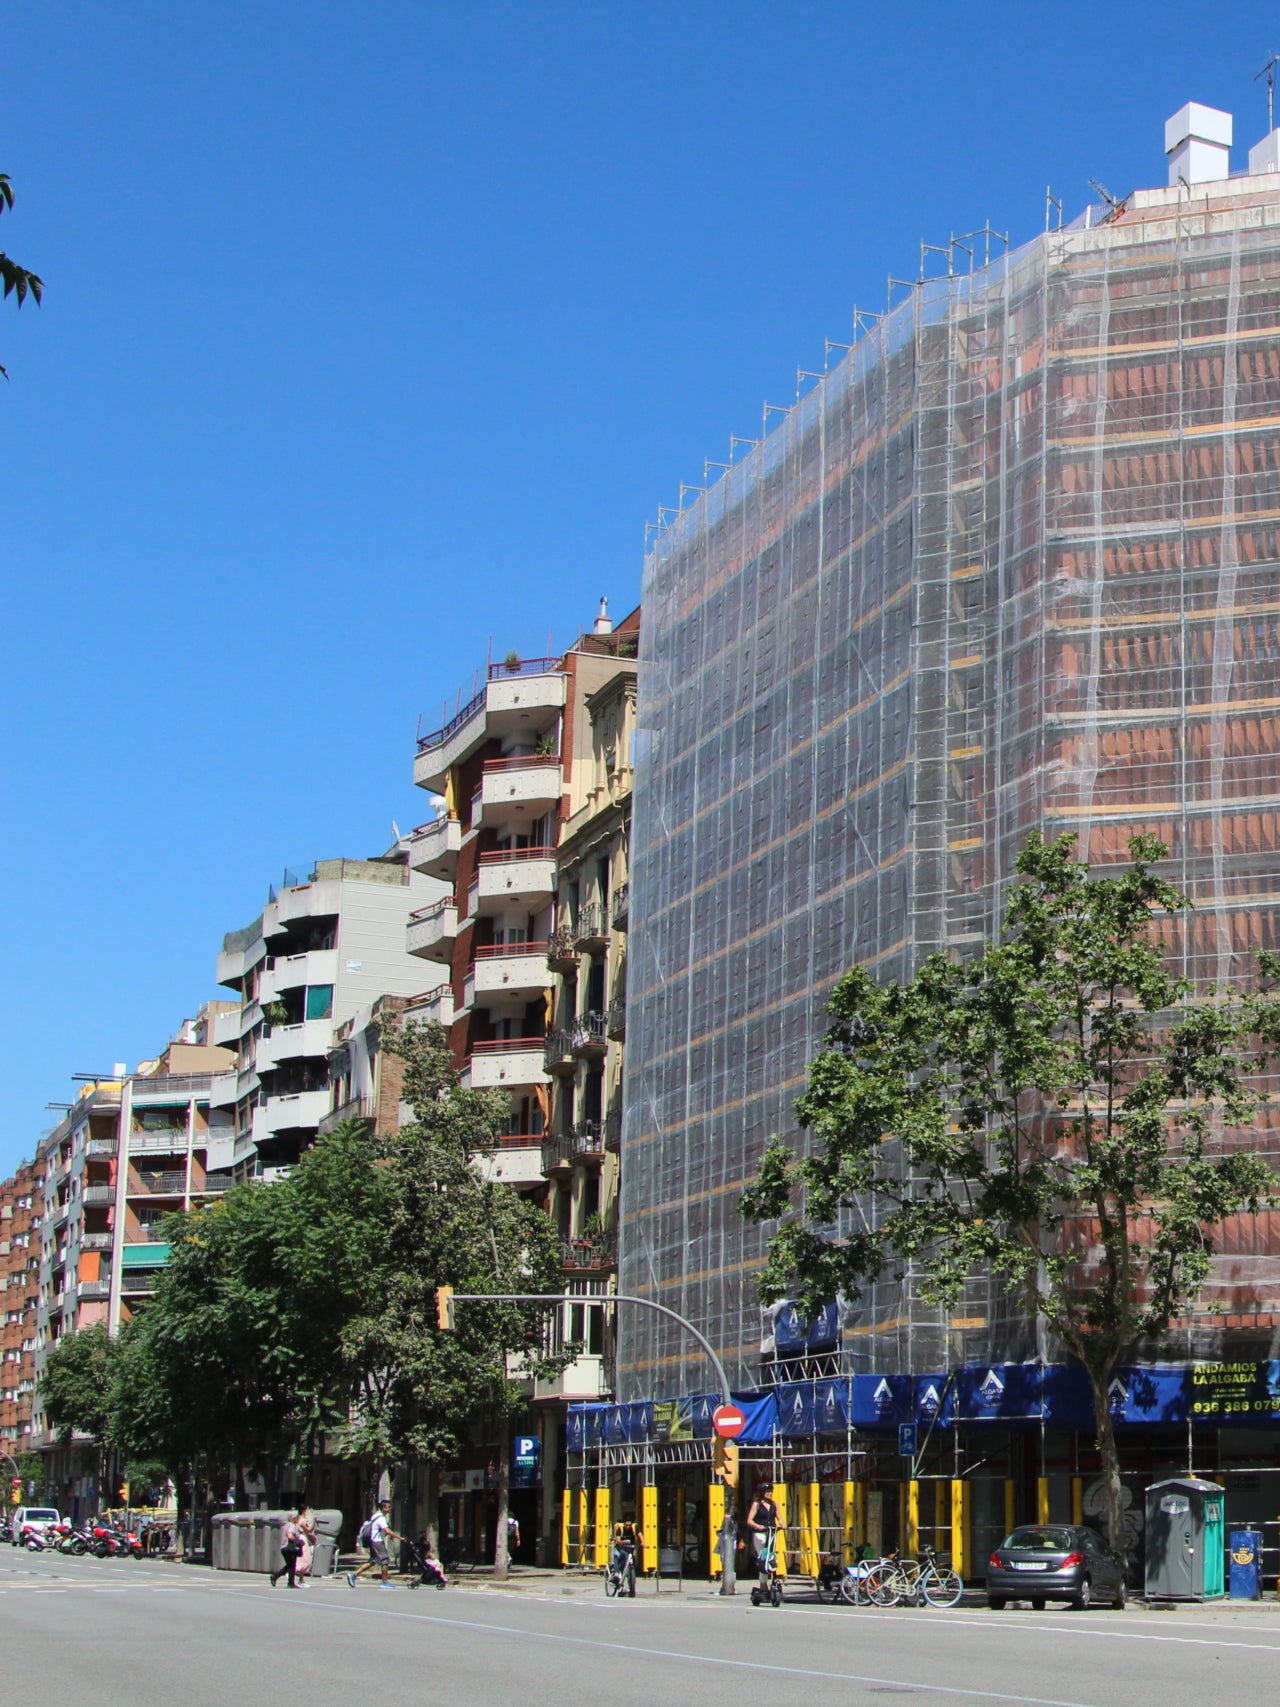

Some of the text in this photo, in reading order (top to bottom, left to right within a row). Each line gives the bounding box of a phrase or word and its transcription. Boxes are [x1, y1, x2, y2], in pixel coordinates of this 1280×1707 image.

[1194, 1362, 1257, 1374] ANDAMIOS
[1193, 1373, 1257, 1385] LA ALGABA
[1194, 1402, 1219, 1413] 936
[1224, 1401, 1250, 1412] 386
[1254, 1400, 1280, 1411] 079
[904, 1428, 912, 1440] P
[521, 1439, 534, 1455] P
